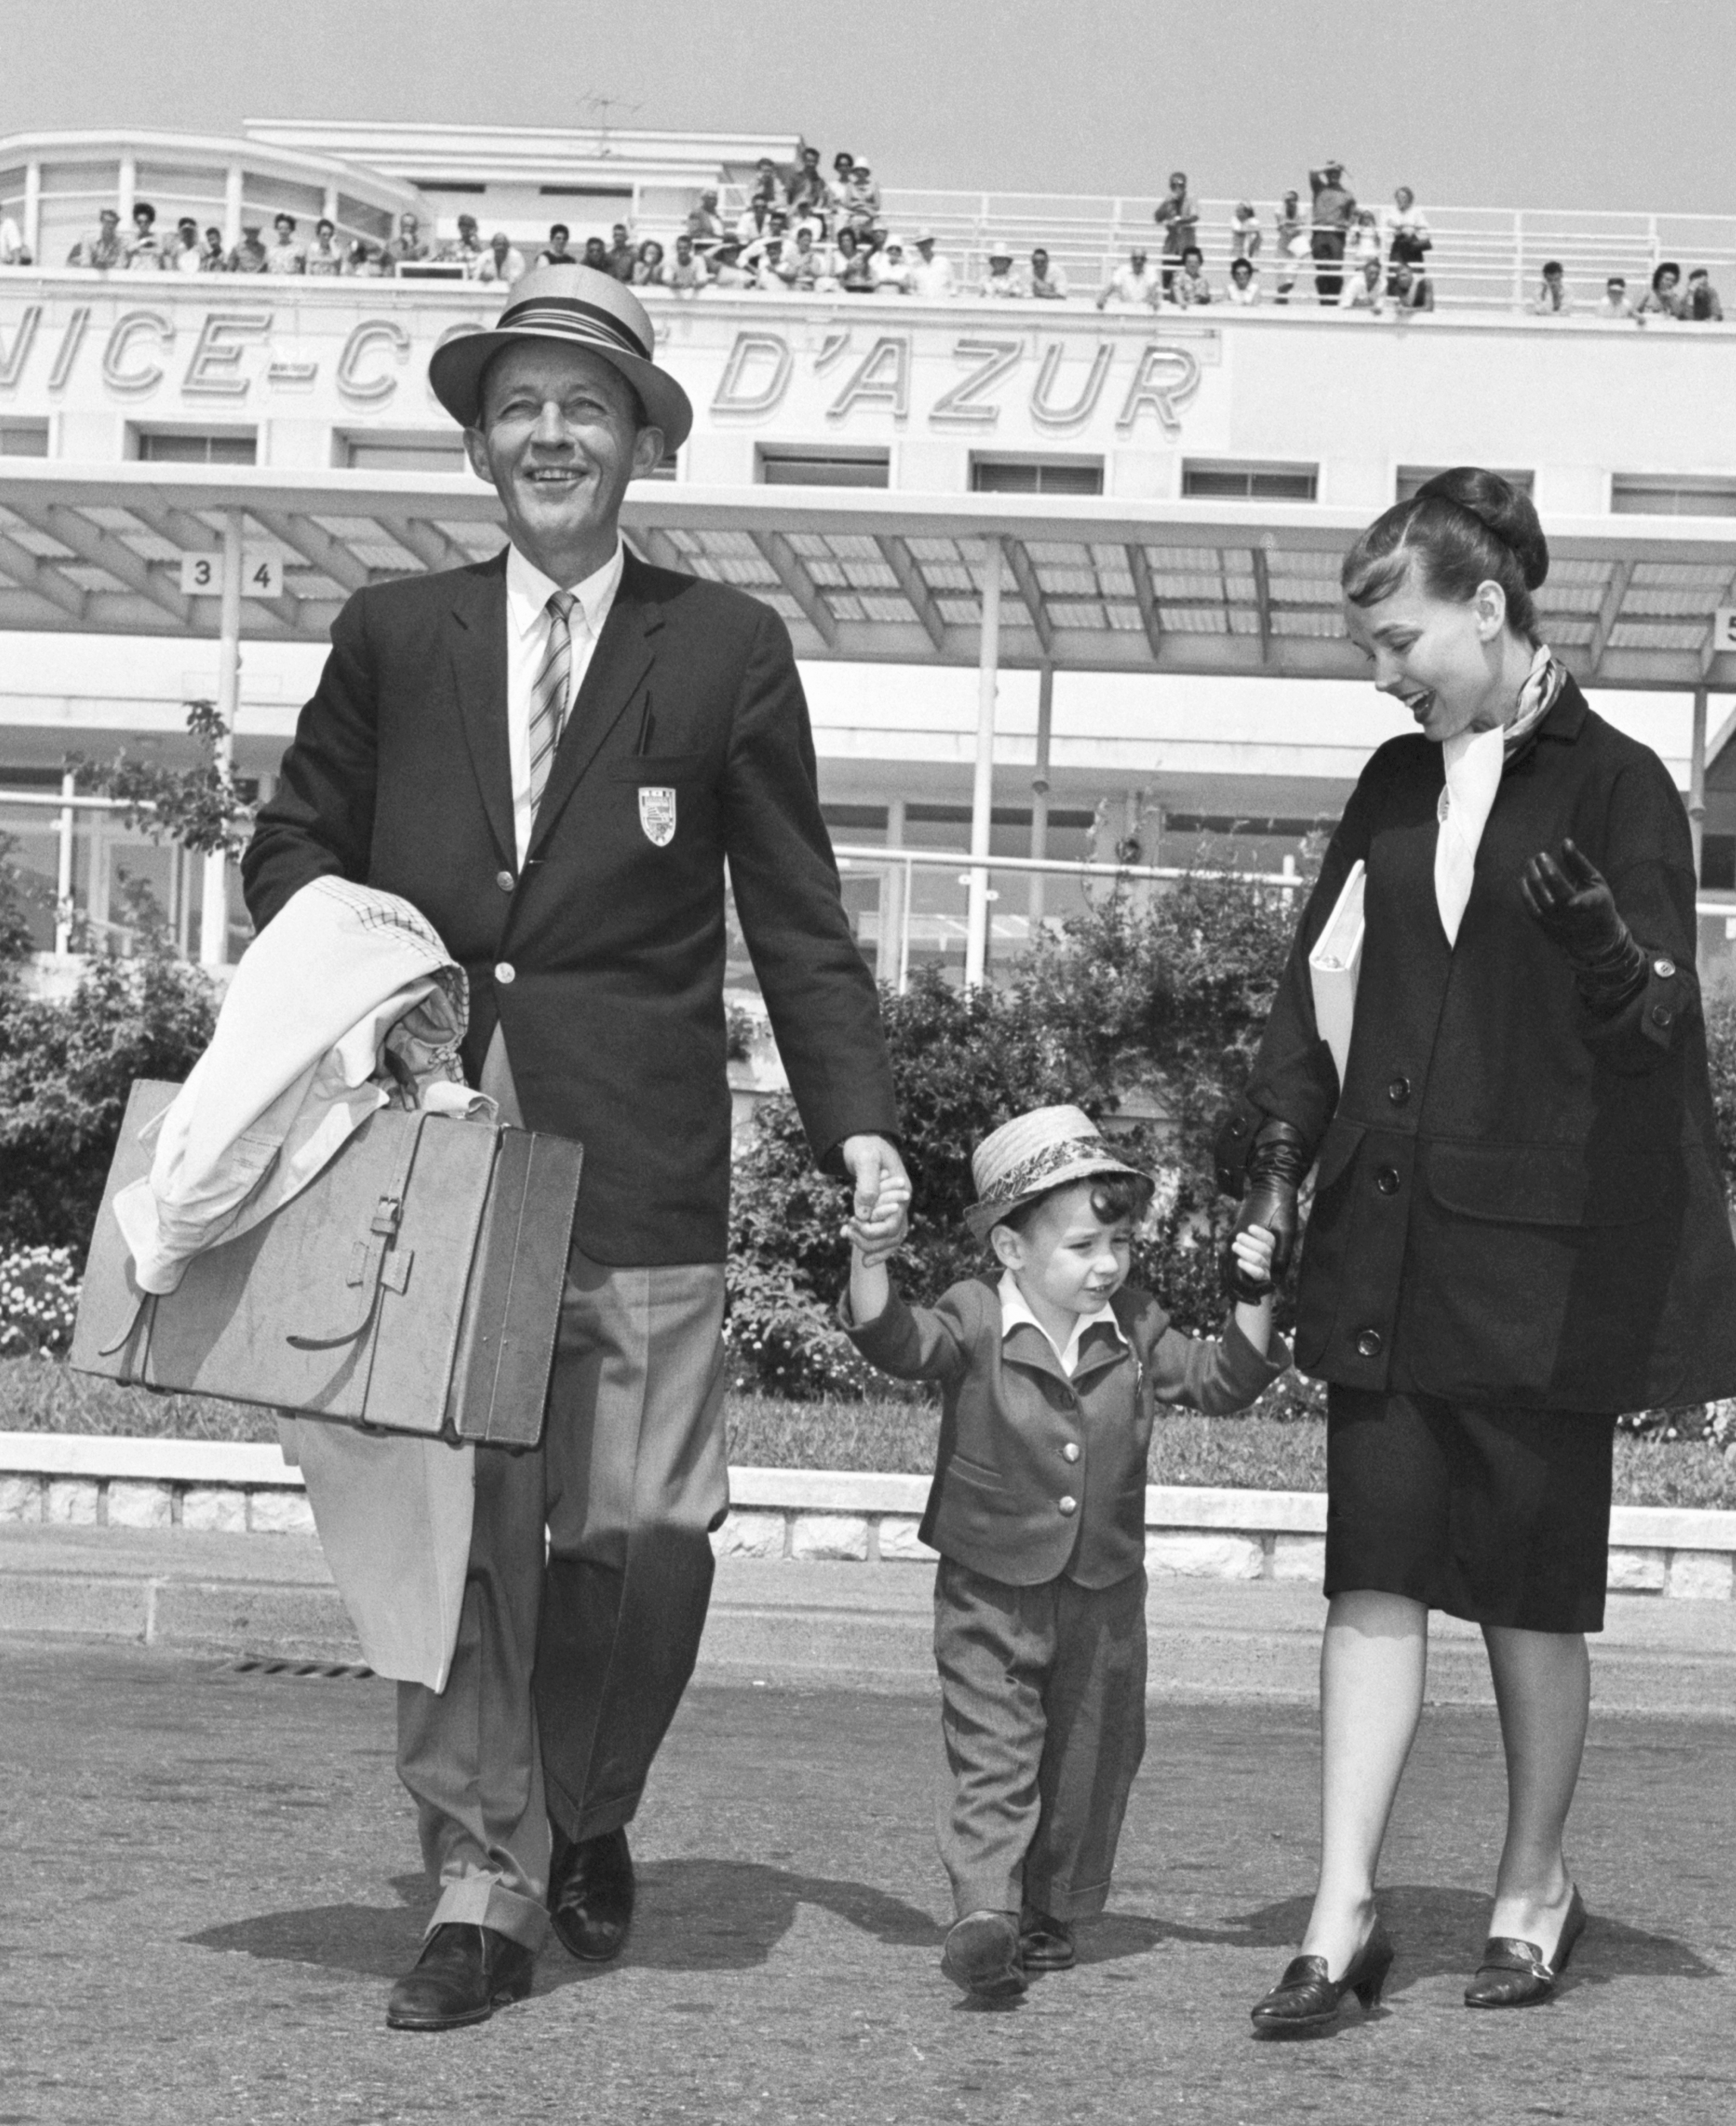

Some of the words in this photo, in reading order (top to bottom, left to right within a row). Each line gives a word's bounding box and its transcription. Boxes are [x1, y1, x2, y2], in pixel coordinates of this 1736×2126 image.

[0, 306, 670, 404] ICE-C
[709, 331, 1200, 429] D'AZUR
[195, 560, 210, 585] 3
[253, 563, 271, 588] 4
